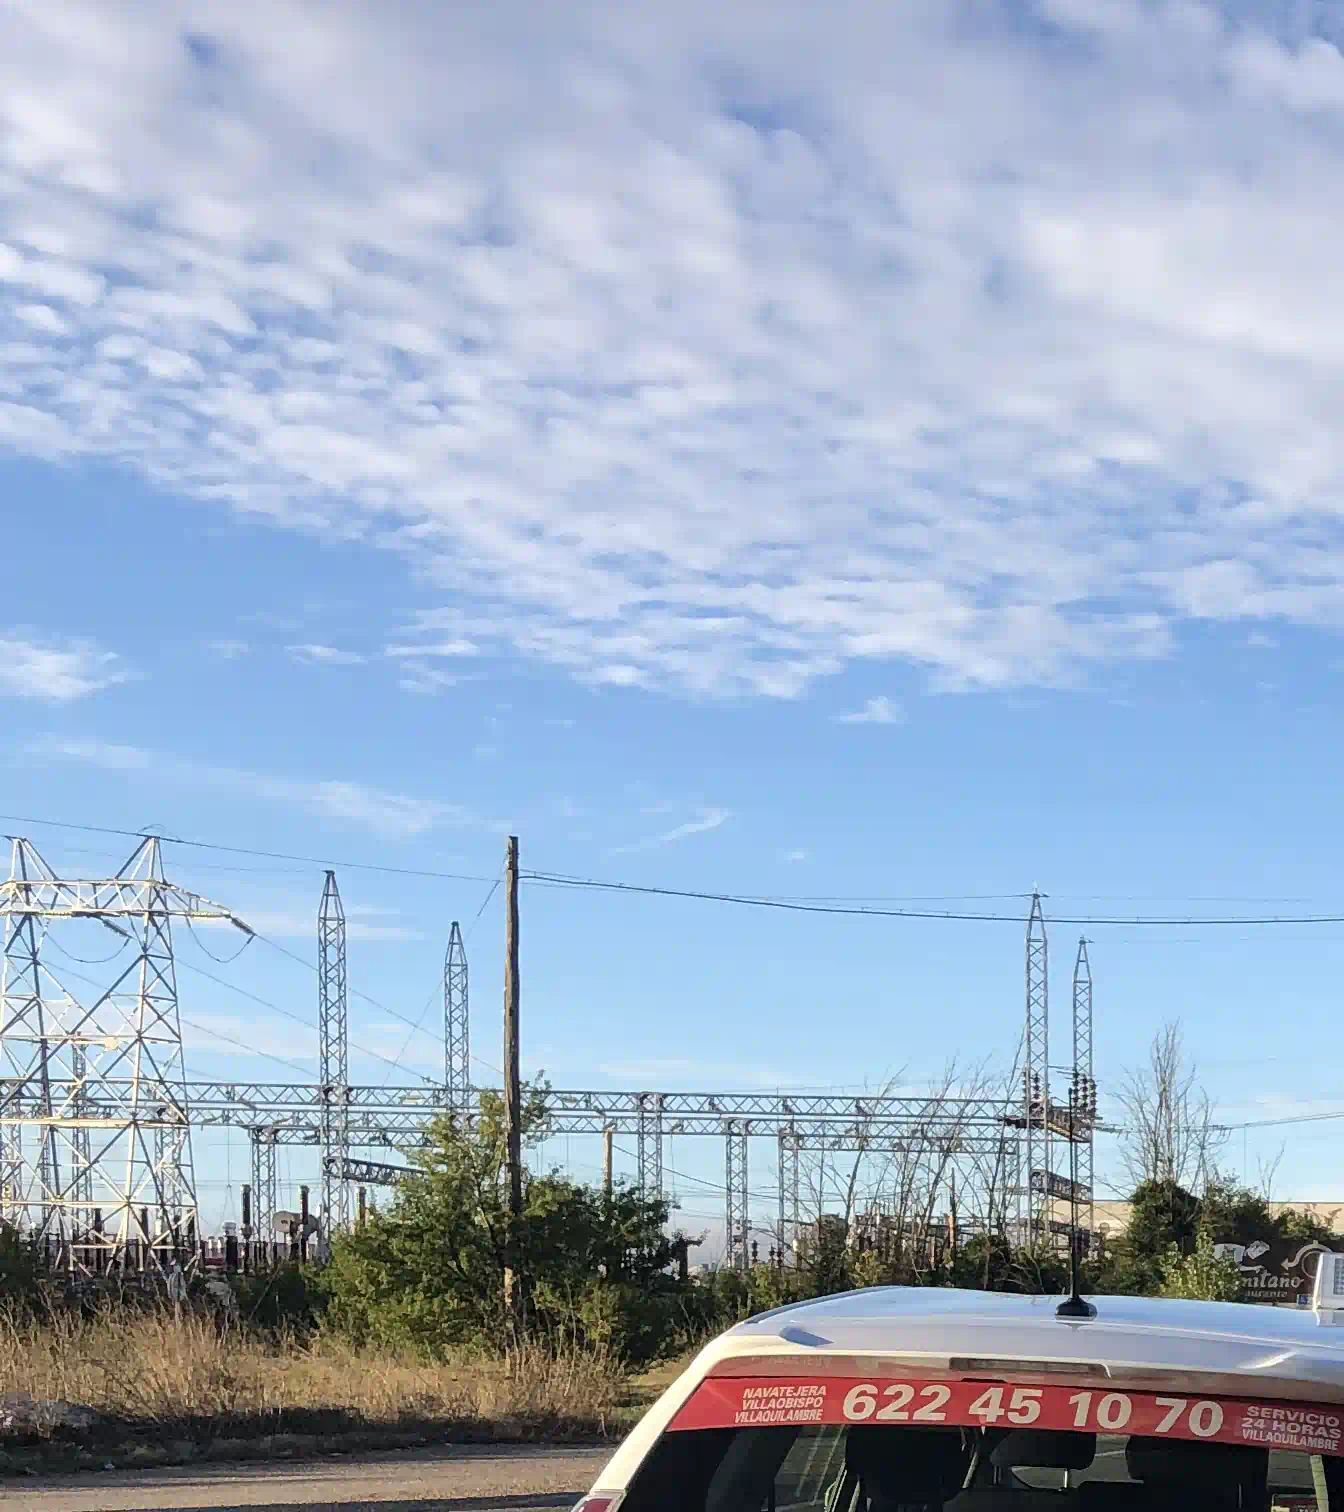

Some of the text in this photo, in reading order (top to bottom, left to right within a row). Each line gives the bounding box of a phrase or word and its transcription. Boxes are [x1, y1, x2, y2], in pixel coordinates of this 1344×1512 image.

[743, 1385, 827, 1399] NAVATEJERA
[742, 1397, 824, 1411] VILLAOBISPO
[842, 1383, 1224, 1437] 622 45 10 70
[734, 1408, 824, 1424] VILLAQUILAMBRE
[1246, 1405, 1340, 1427] SERVICIO
[1241, 1417, 1342, 1439] 24 HORAS
[1242, 1428, 1339, 1450] VILLAQUILAMBRE
